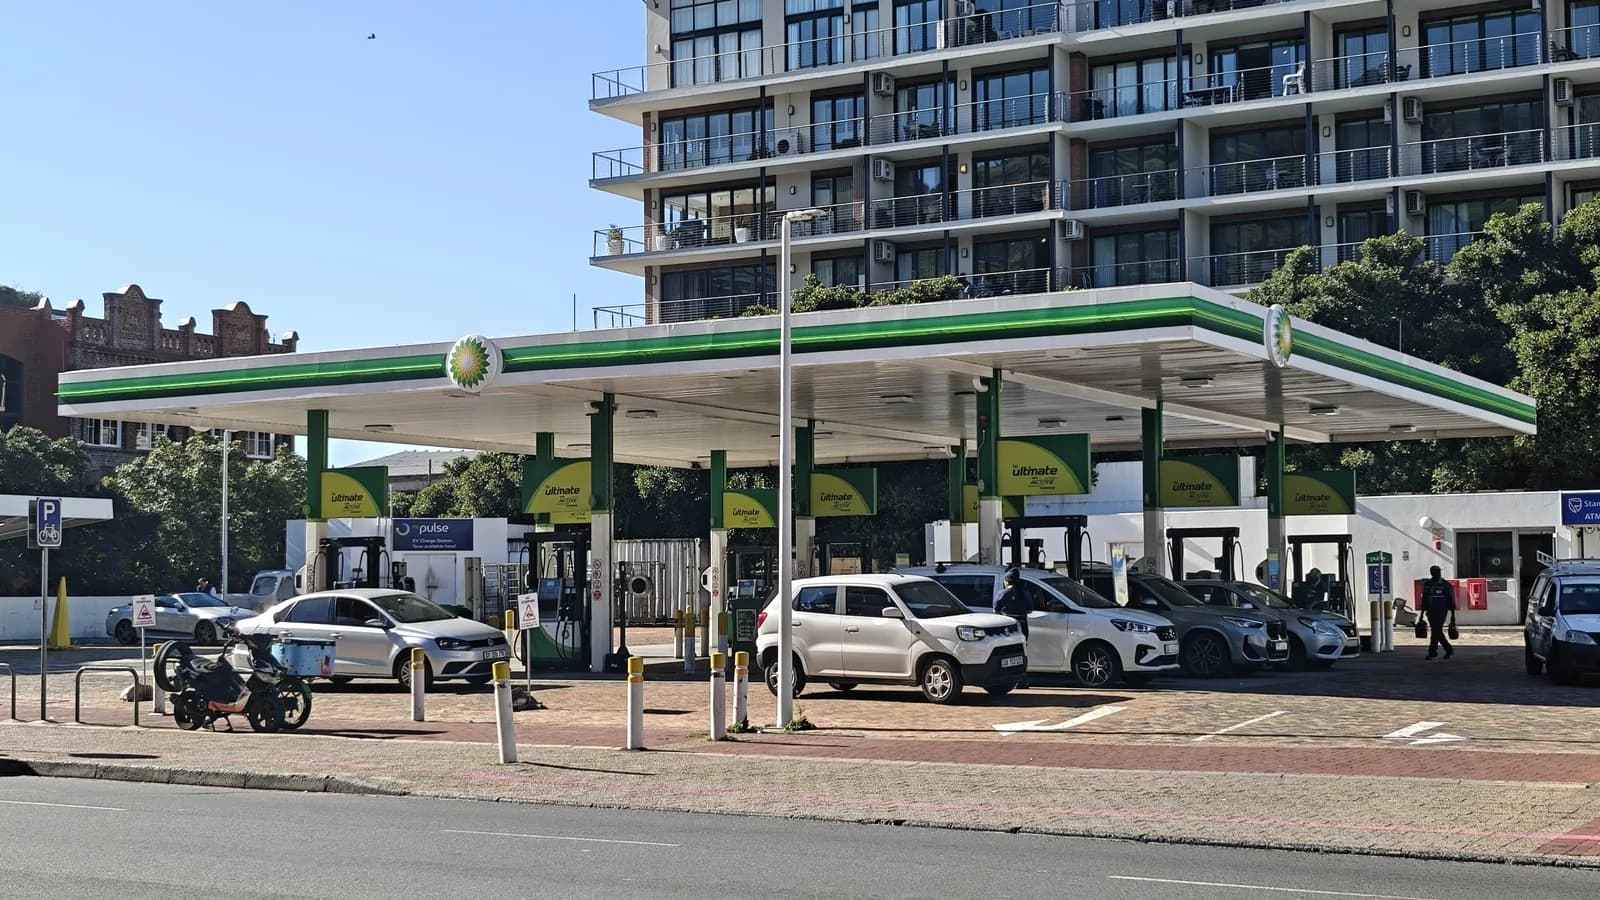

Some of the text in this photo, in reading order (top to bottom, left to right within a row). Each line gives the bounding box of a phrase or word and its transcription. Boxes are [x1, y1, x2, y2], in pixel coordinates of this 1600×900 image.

[1012, 465, 1058, 476] ultimate
[545, 485, 581, 495] ultimate
[1172, 481, 1213, 491] ultimate
[331, 492, 363, 502] ultimate
[820, 492, 853, 501] ultimate
[1296, 493, 1332, 502] ultimate
[44, 501, 55, 520] P
[732, 508, 760, 516] ultimate
[1584, 512, 1600, 520] ATM
[419, 522, 449, 535] pulse
